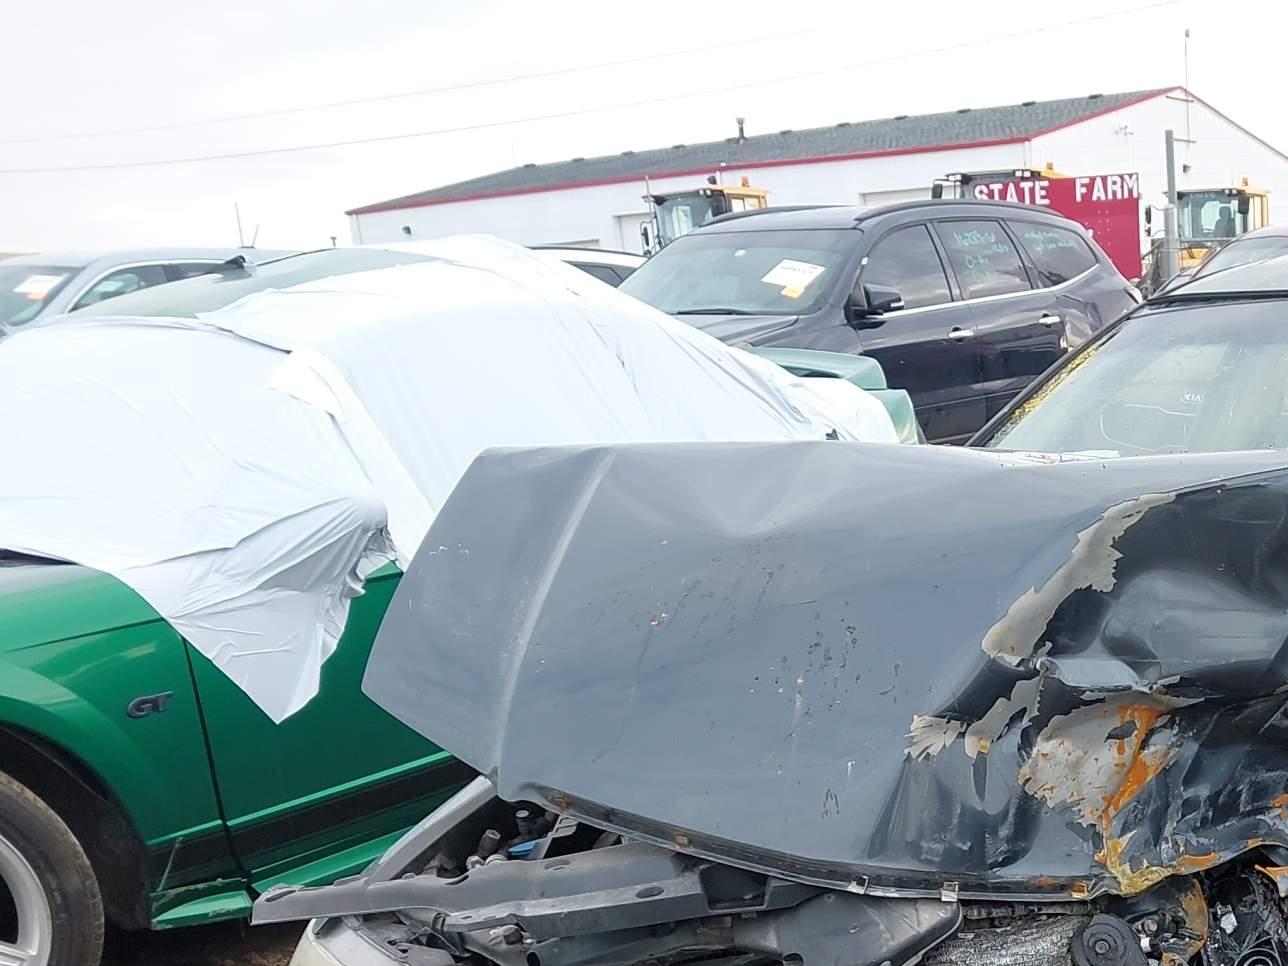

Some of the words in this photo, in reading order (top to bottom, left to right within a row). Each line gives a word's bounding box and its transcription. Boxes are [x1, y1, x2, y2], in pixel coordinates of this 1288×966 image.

[974, 180, 1051, 205] STATE
[1075, 174, 1138, 203] FARM
[127, 690, 175, 719] GT
